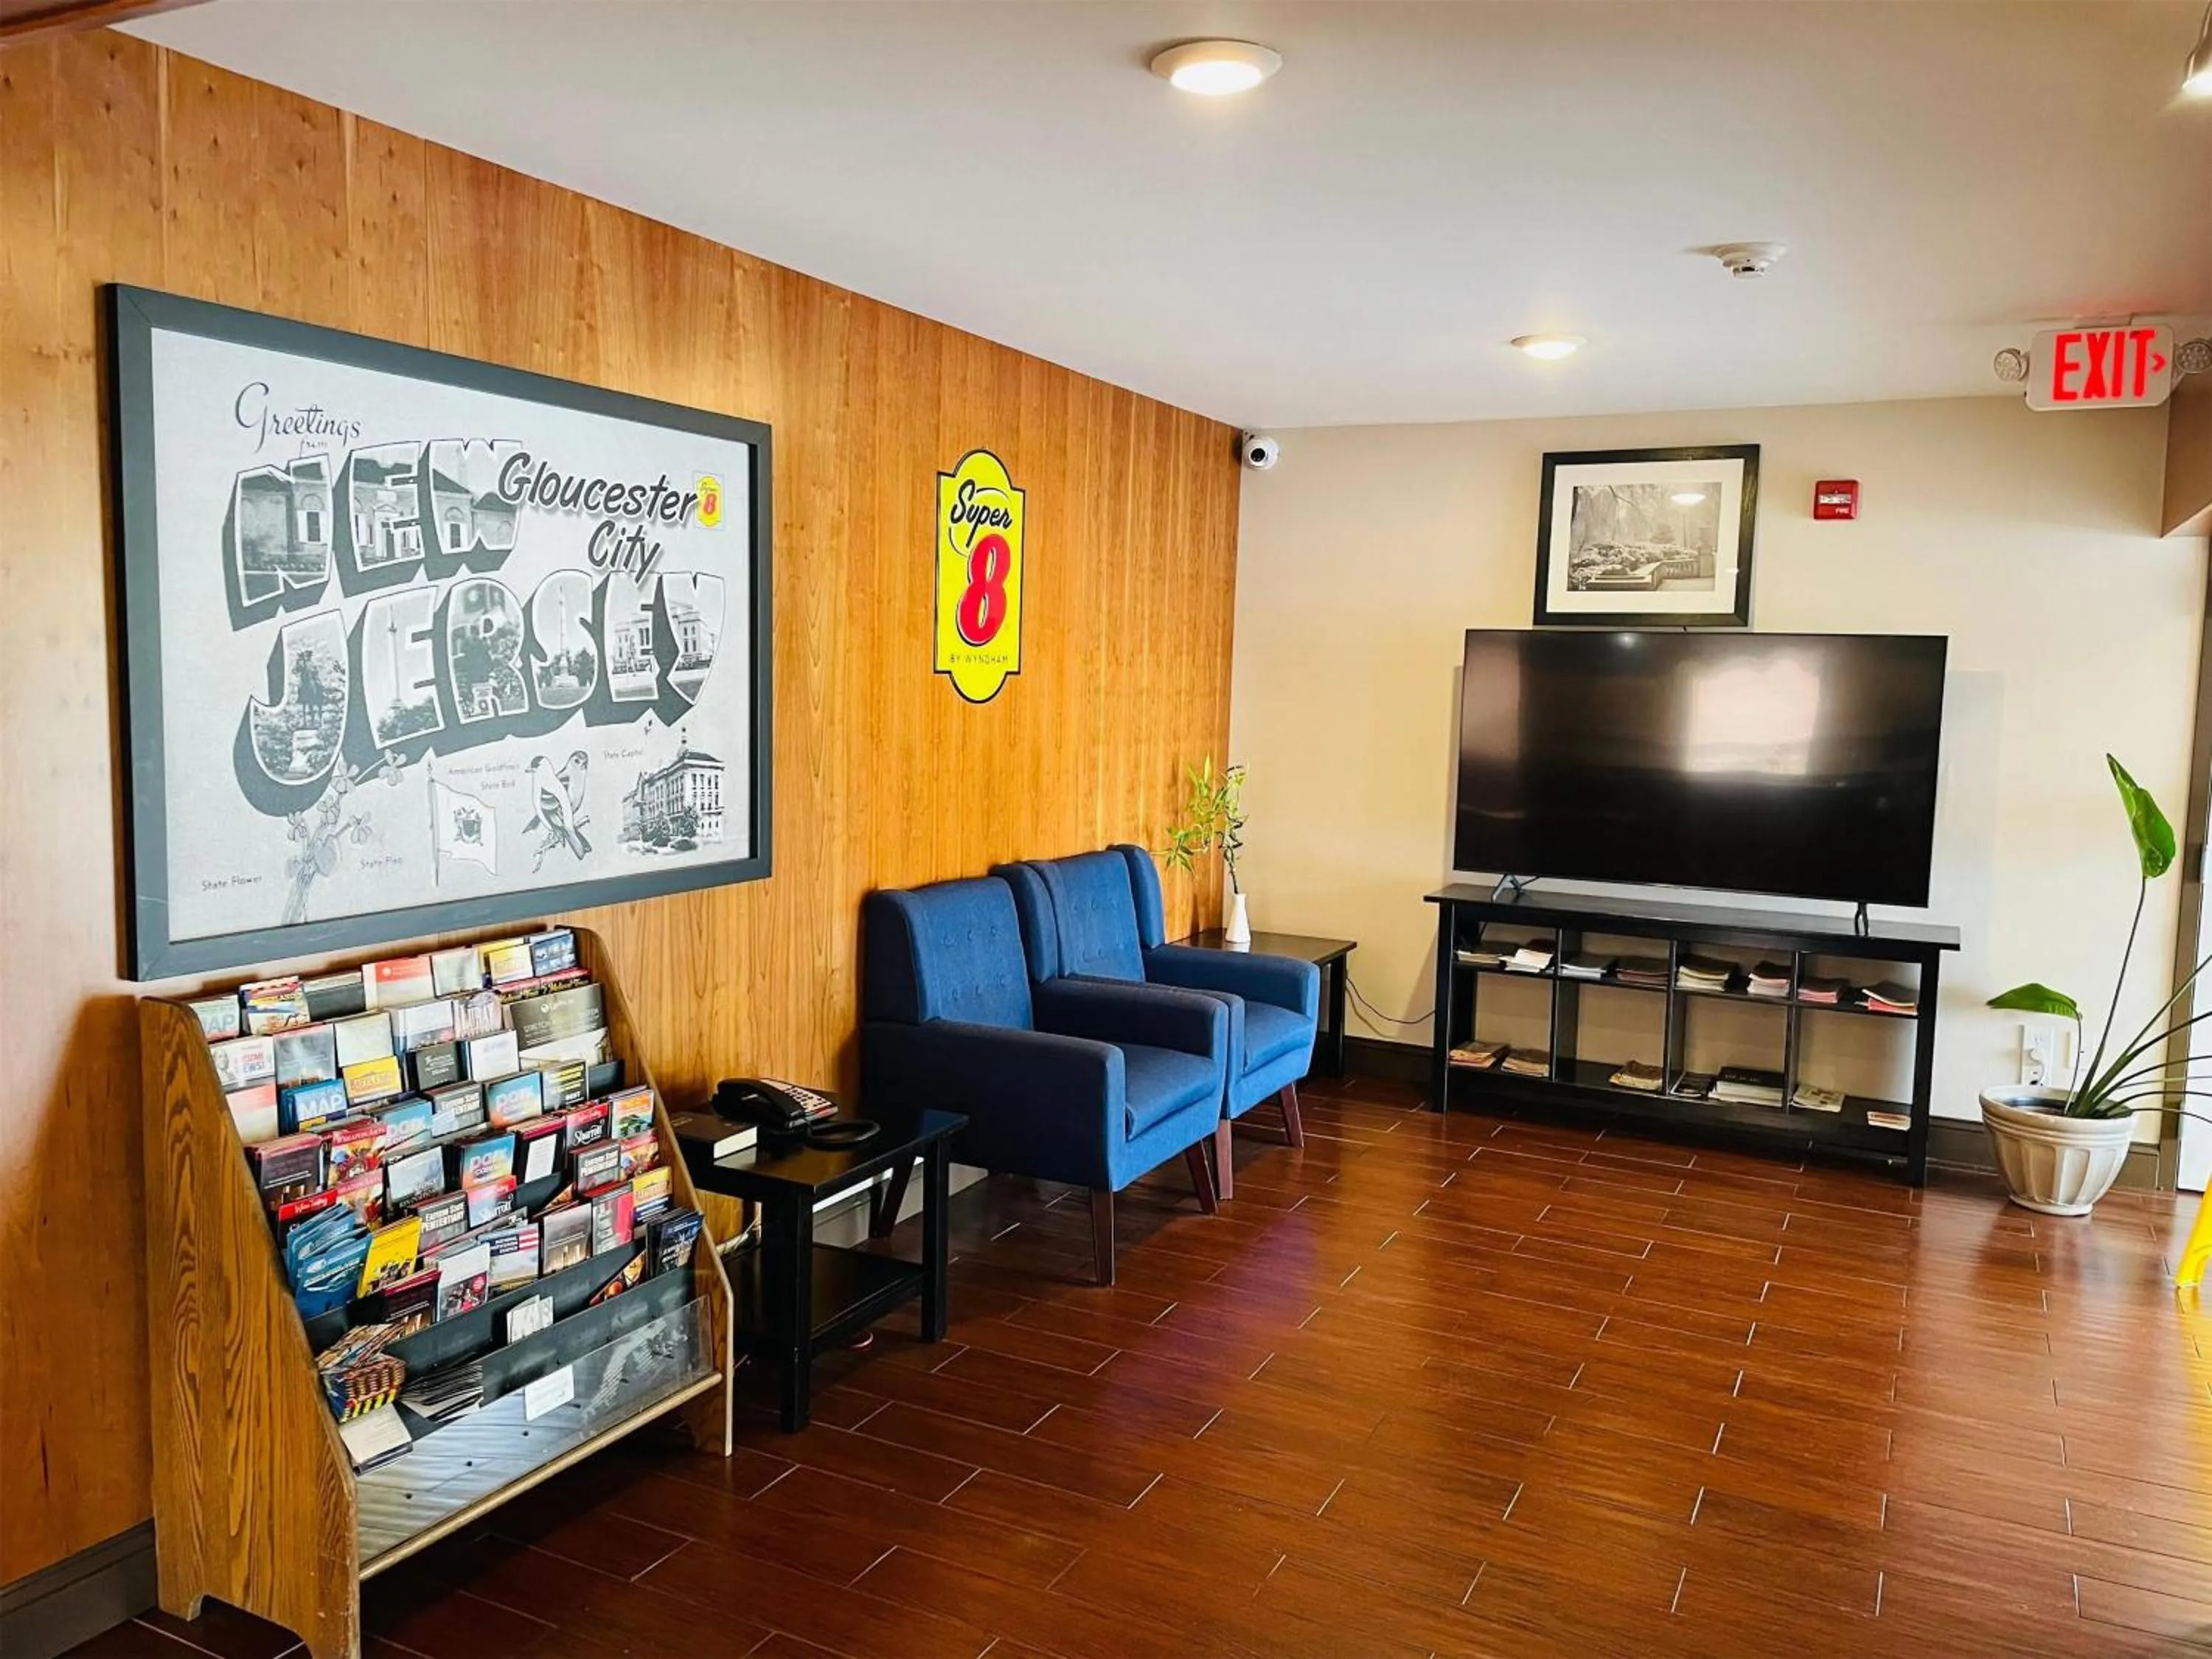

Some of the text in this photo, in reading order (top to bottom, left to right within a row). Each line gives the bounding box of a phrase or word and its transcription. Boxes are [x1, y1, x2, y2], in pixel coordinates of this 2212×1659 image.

[2053, 329, 2155, 402] EXIT
[235, 381, 364, 454] Greetings
[498, 451, 698, 521] Gloucester
[950, 479, 1013, 549] Super
[224, 438, 524, 627] NEW
[588, 519, 661, 584] City
[956, 533, 1011, 647] 8
[235, 569, 726, 811] JERSEY
[950, 653, 1009, 665] BY WYNDHAM
[299, 1093, 344, 1119] MAP
